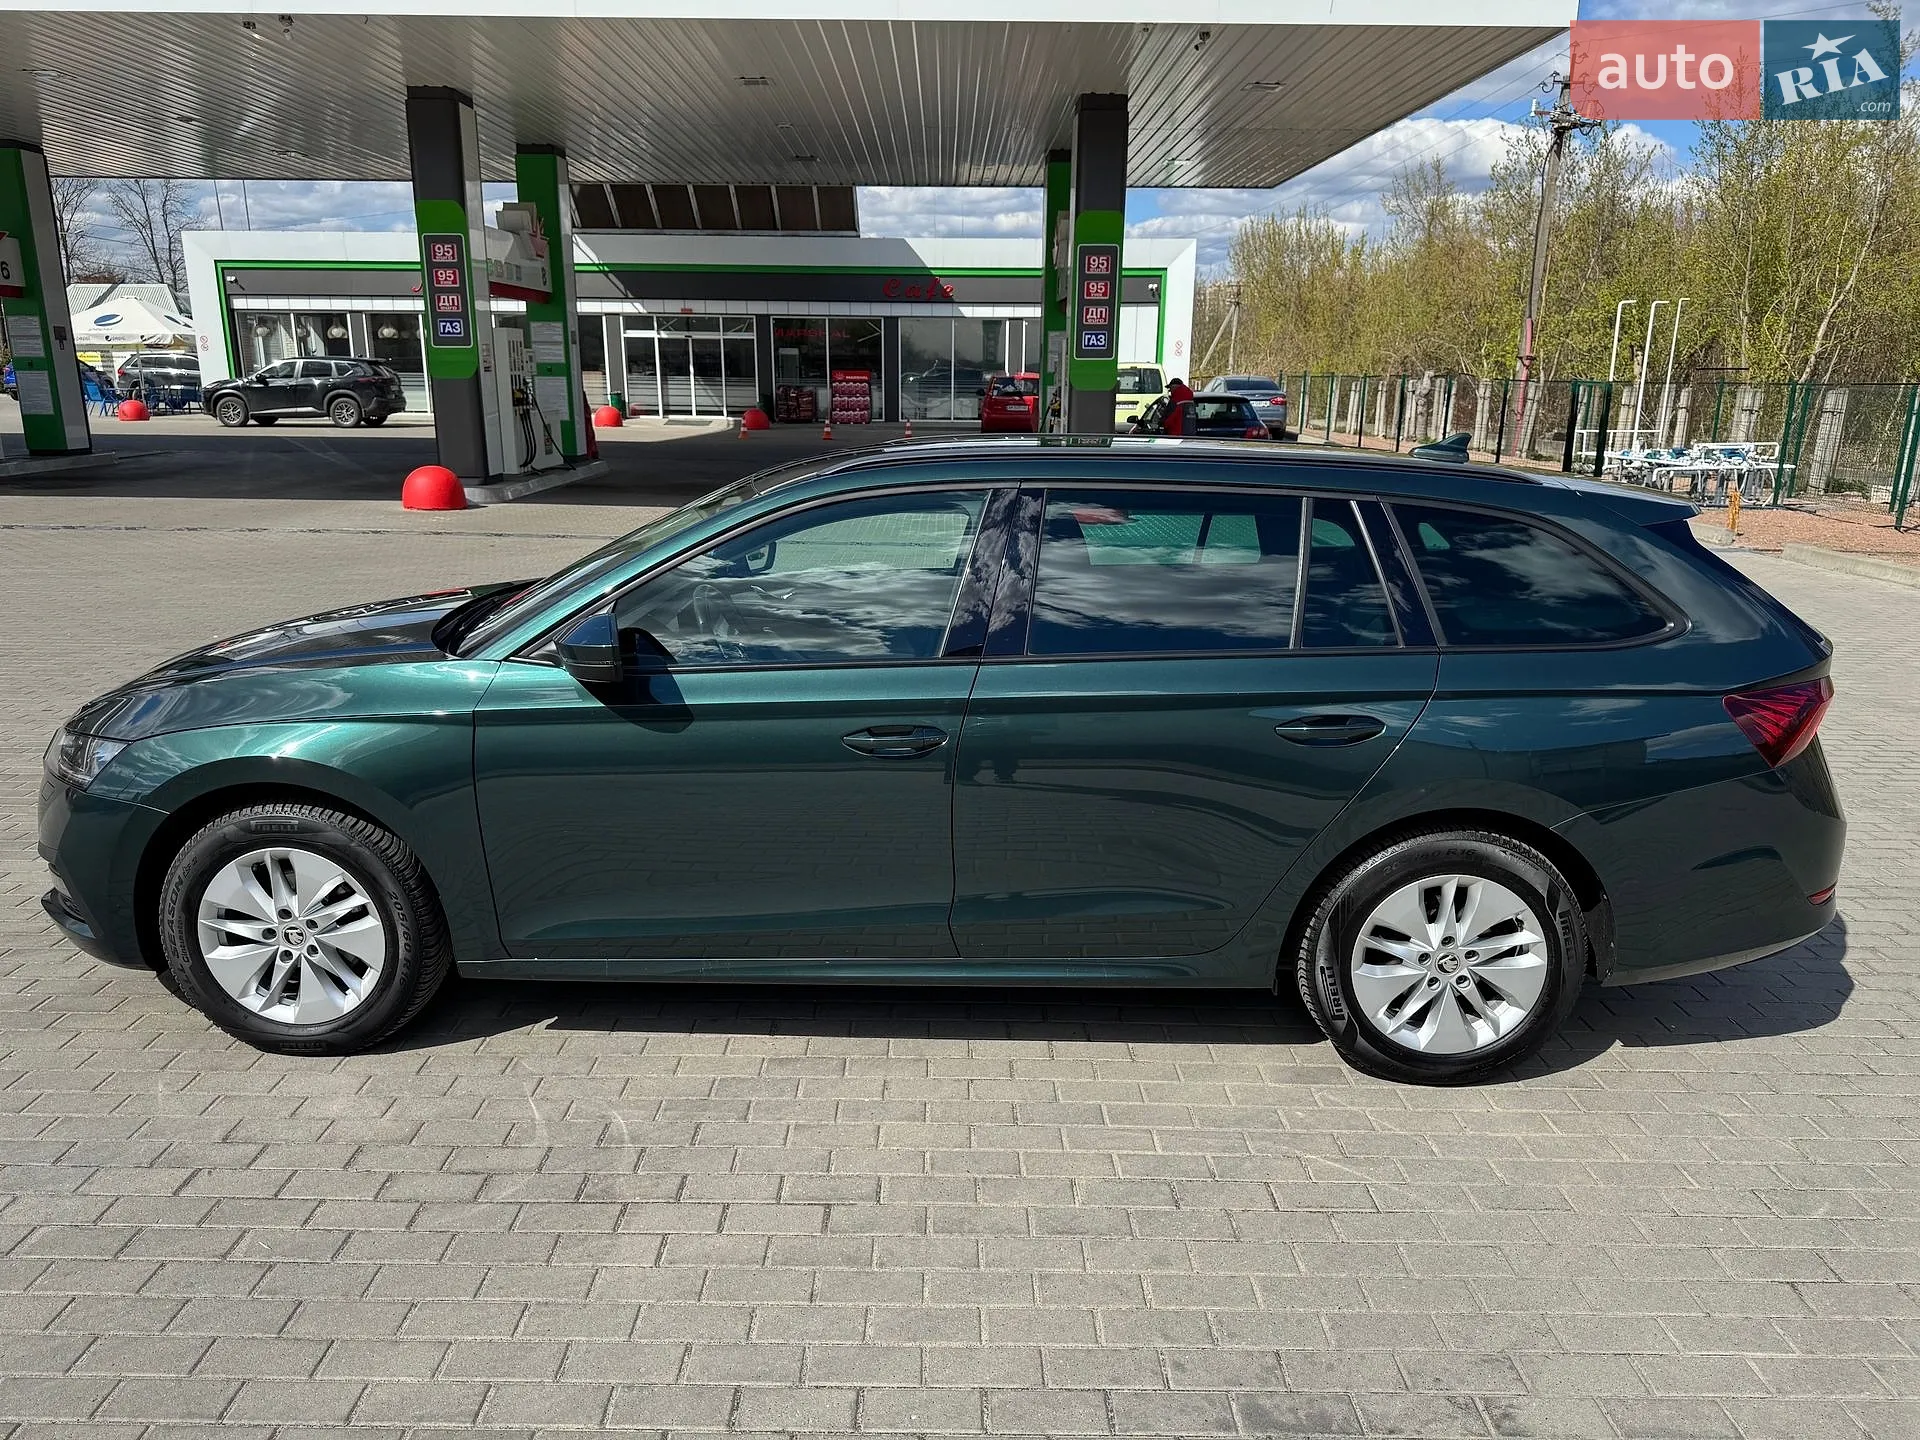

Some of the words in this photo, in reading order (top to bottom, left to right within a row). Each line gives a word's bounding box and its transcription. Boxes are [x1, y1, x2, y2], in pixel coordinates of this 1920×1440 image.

[434, 244, 453, 257] 95
[1089, 256, 1107, 269] 95
[437, 270, 454, 280] 95
[882, 276, 955, 301] Cafe
[1089, 282, 1106, 294] 95
[439, 295, 458, 307] ДП
[1086, 307, 1106, 319] ДП
[439, 321, 461, 334] ГАЗ
[1084, 334, 1106, 346] ГАЗ
[167, 874, 184, 960] SEASON
[386, 890, 413, 953] 205/60
[1319, 965, 1347, 1021] PIRELLI
